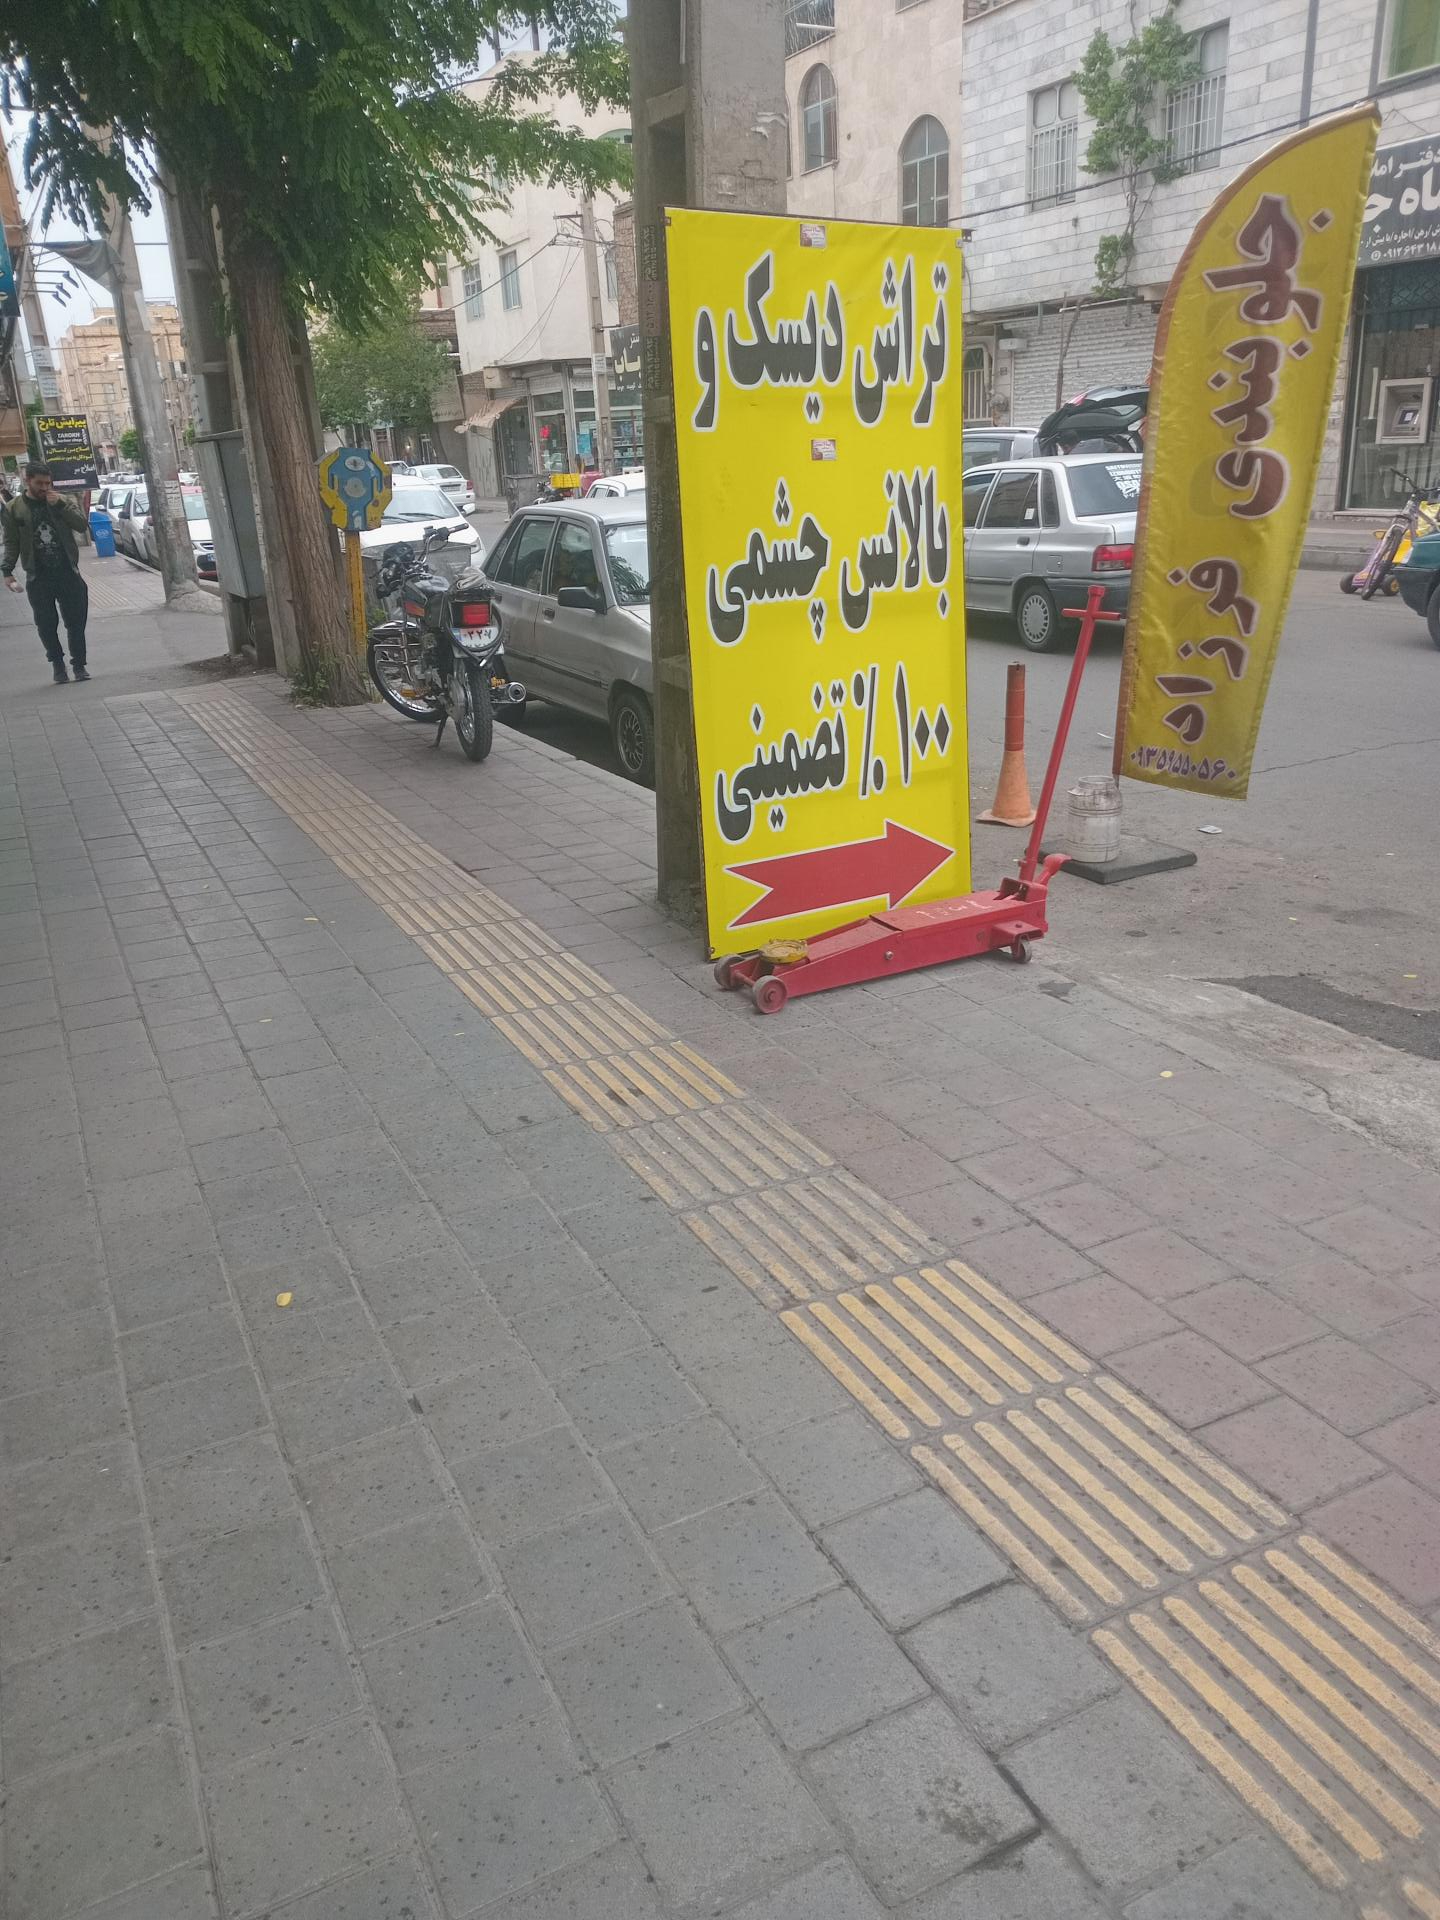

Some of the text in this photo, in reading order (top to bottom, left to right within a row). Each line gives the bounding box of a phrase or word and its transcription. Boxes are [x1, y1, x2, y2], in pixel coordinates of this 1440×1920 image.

[694, 251, 948, 431] تراش دیسک و
[706, 467, 948, 648] بالانس چشمی
[1155, 193, 1333, 743] جلوبندی فرزاد
[715, 682, 847, 842] تضمینی
